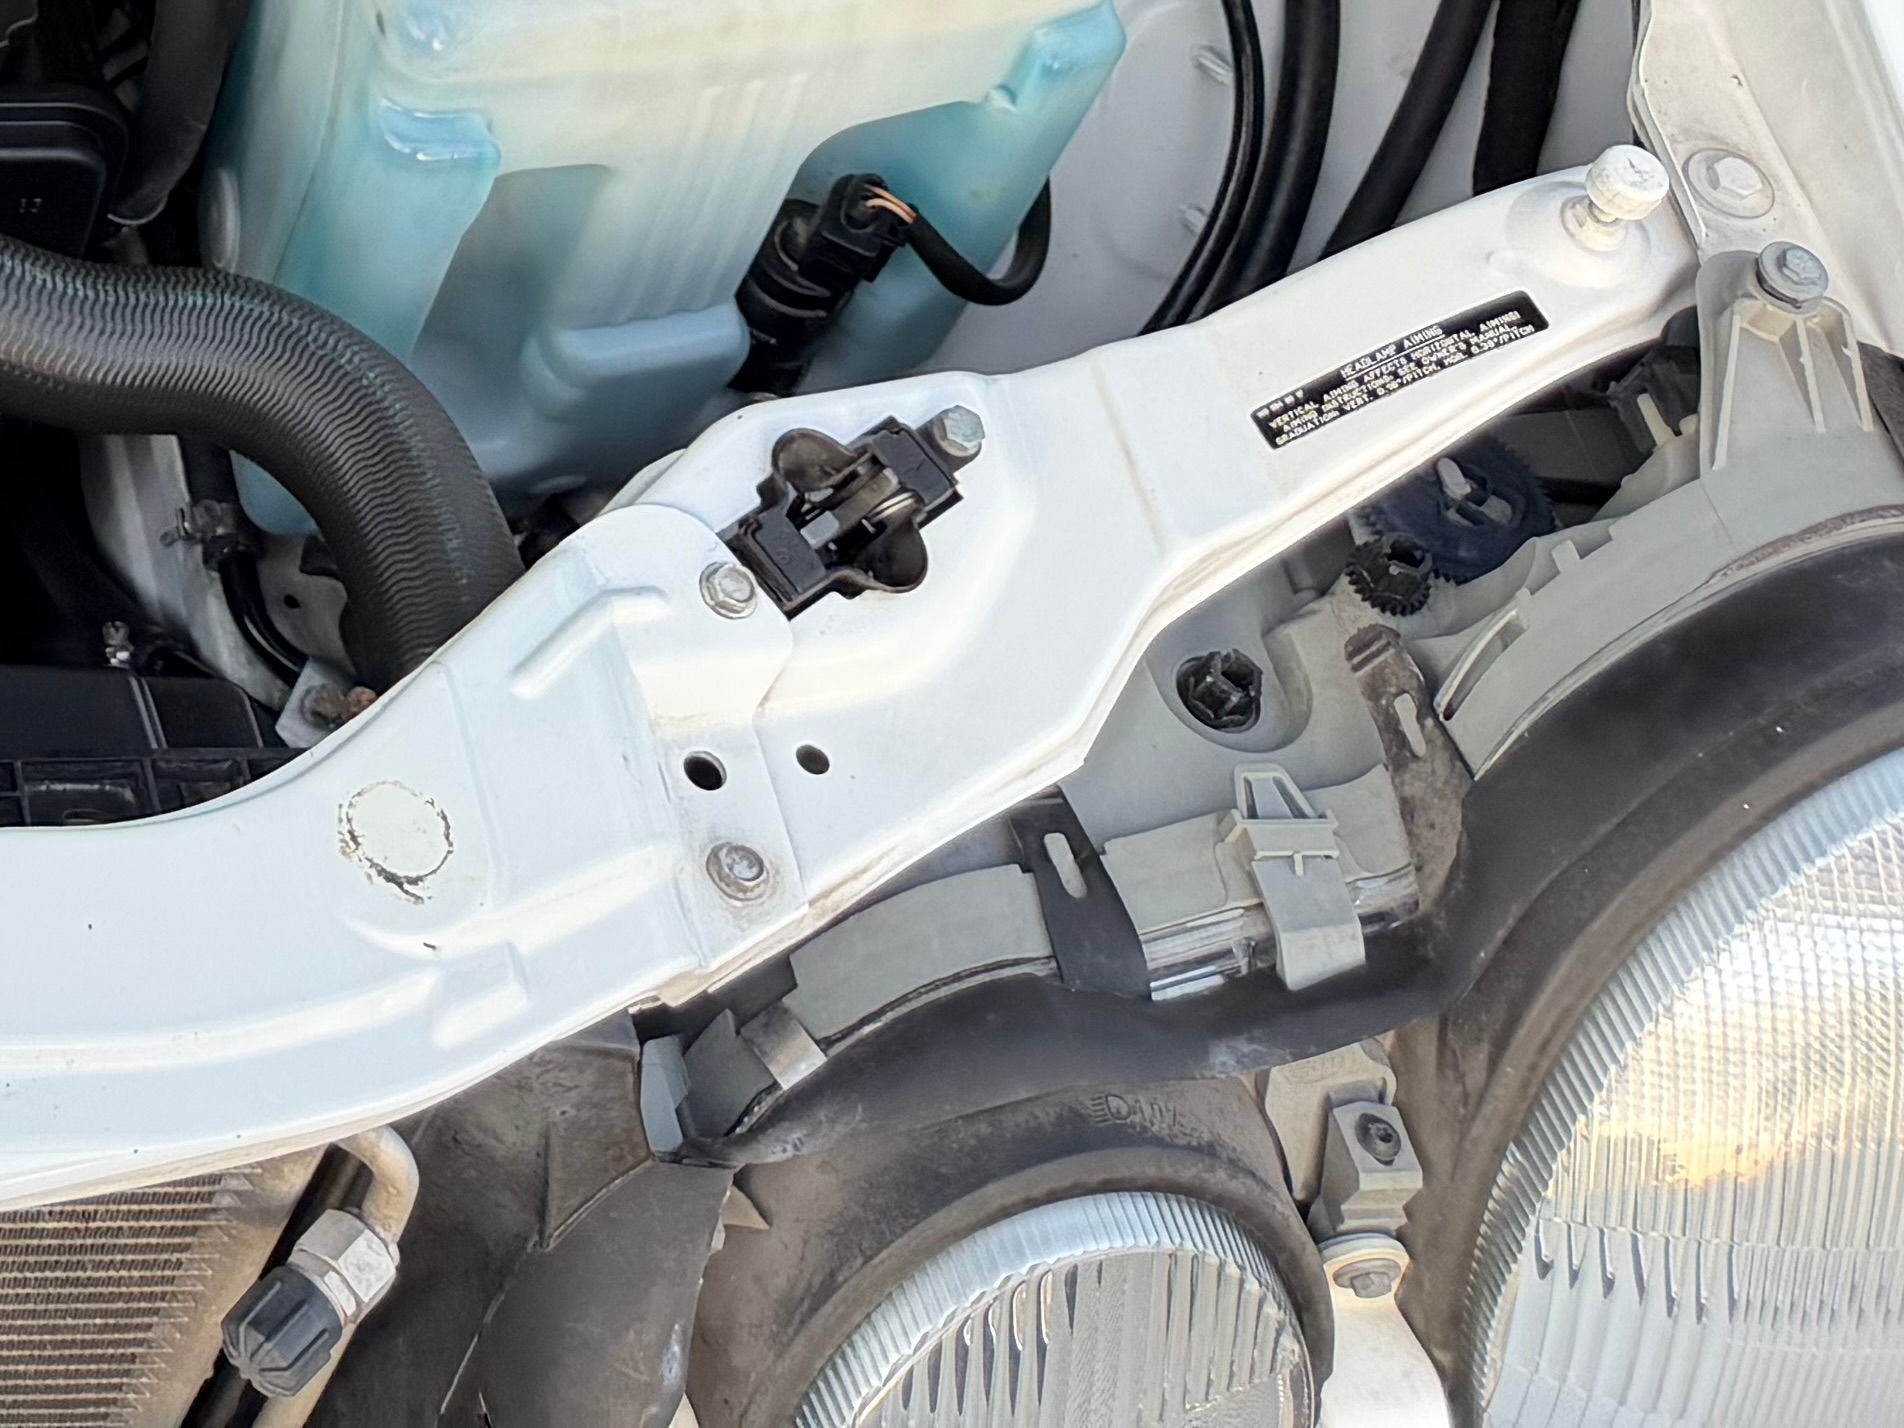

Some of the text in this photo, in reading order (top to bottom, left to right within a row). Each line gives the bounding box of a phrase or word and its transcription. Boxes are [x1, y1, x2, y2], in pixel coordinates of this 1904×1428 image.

[1341, 325, 1442, 377] HEADLAMP AIMING
[1269, 401, 1319, 429] VERTICAL
[1323, 380, 1359, 402] AIMING
[1363, 359, 1408, 384] AFFECTS
